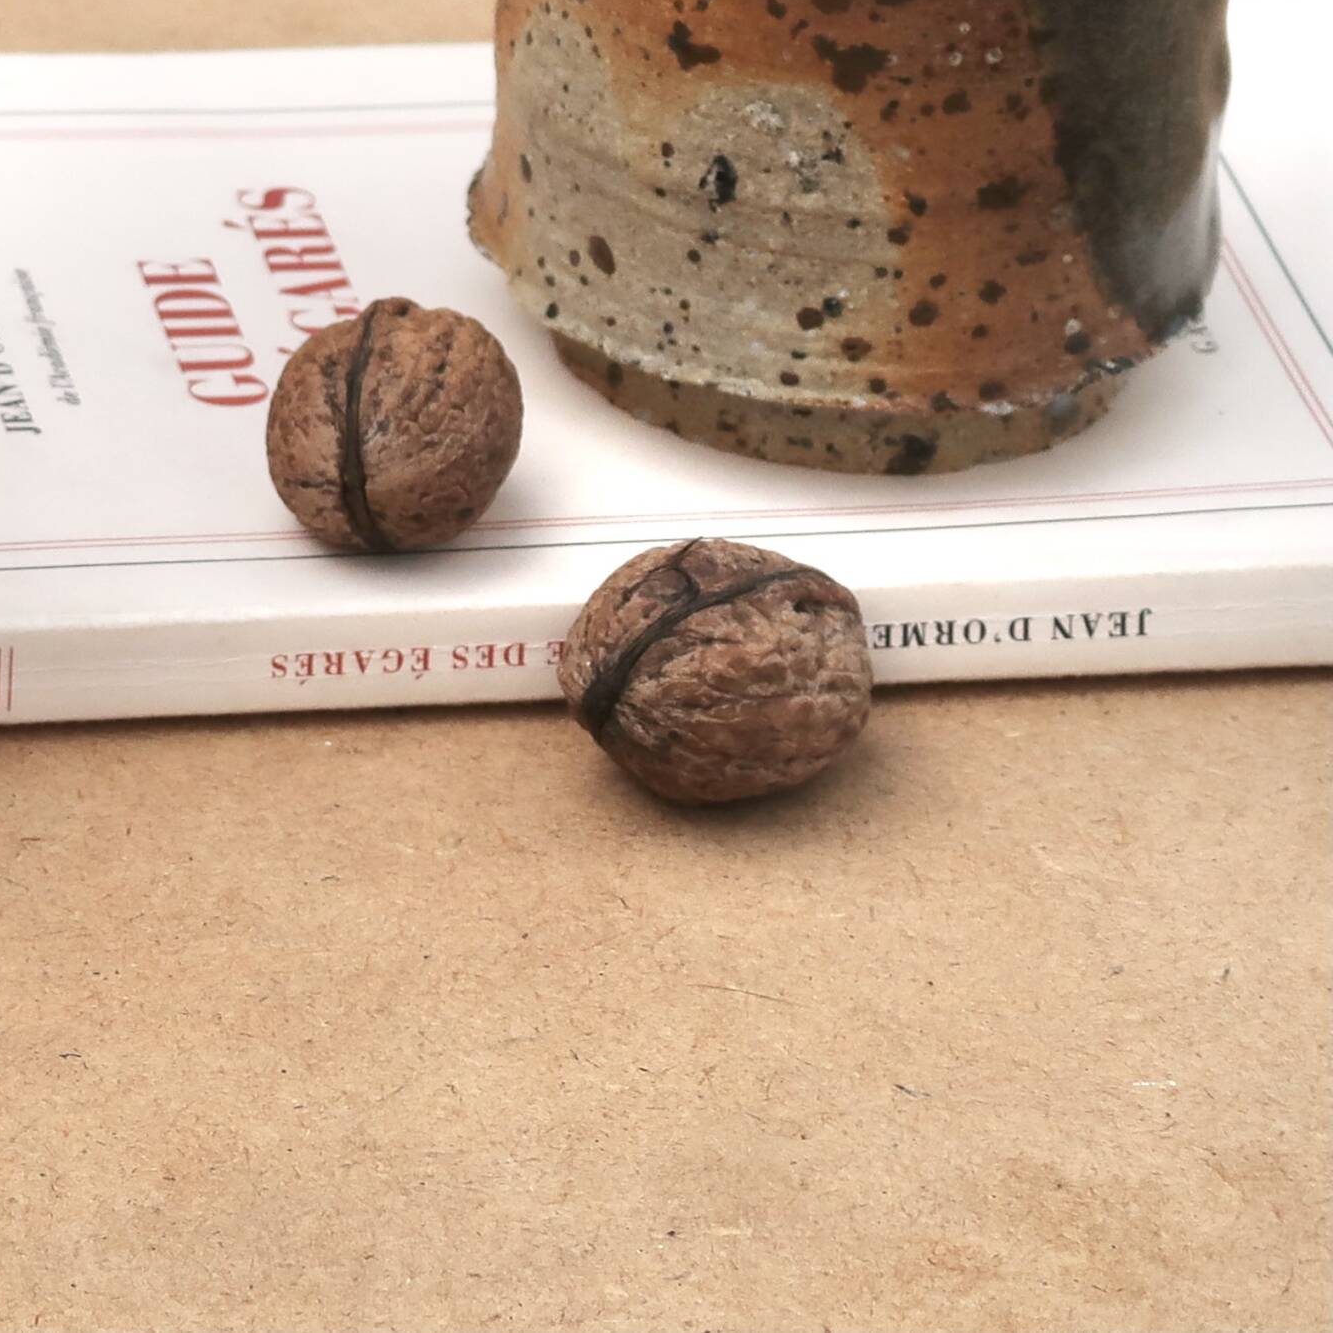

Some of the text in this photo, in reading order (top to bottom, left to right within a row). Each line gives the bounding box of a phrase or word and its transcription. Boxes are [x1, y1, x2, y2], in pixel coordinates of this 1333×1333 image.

[222, 186, 364, 355] GARÉS
[137, 258, 270, 407] GUIDE
[872, 608, 1153, 650] JEAN D'ORME
[270, 646, 432, 685] ÉGARÉS
[451, 641, 528, 670] DES
